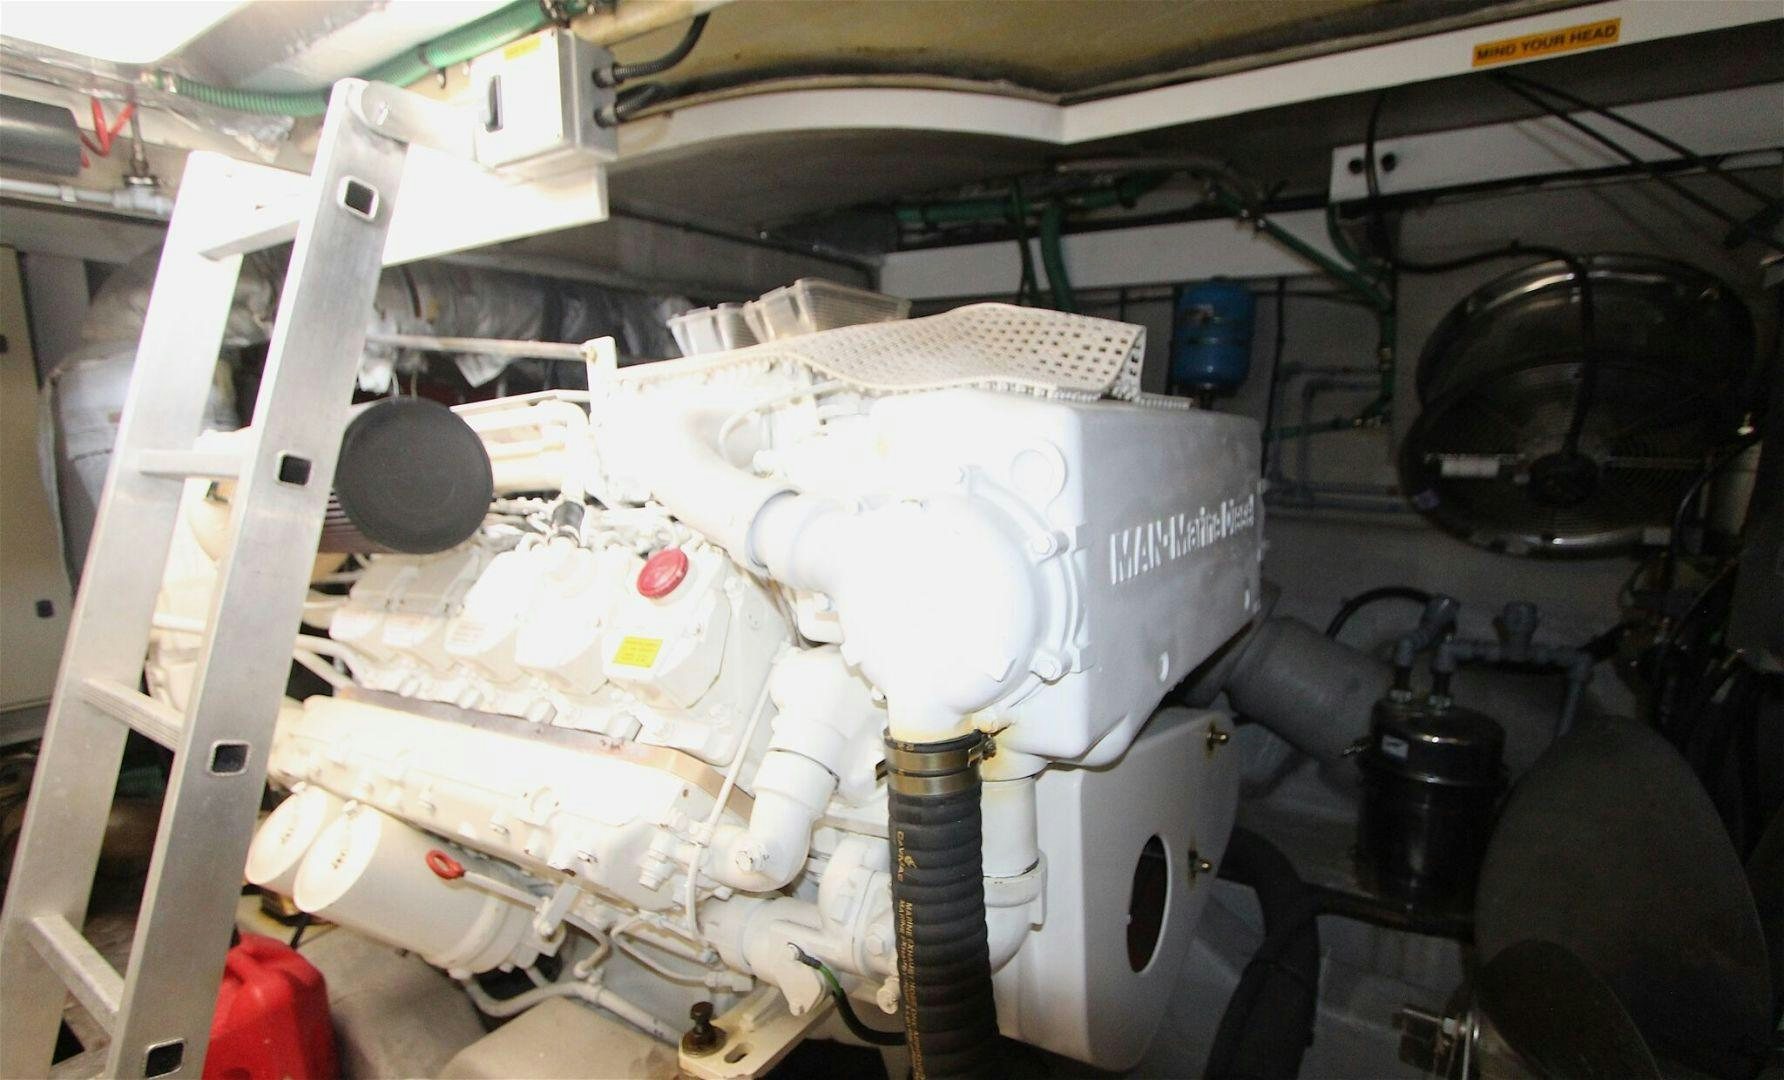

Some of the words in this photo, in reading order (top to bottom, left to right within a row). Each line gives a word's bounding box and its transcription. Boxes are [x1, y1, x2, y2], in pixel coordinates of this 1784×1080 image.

[1477, 44, 1516, 60] MIND
[1521, 34, 1564, 51] YOUR
[1570, 24, 1617, 43] HEAD
